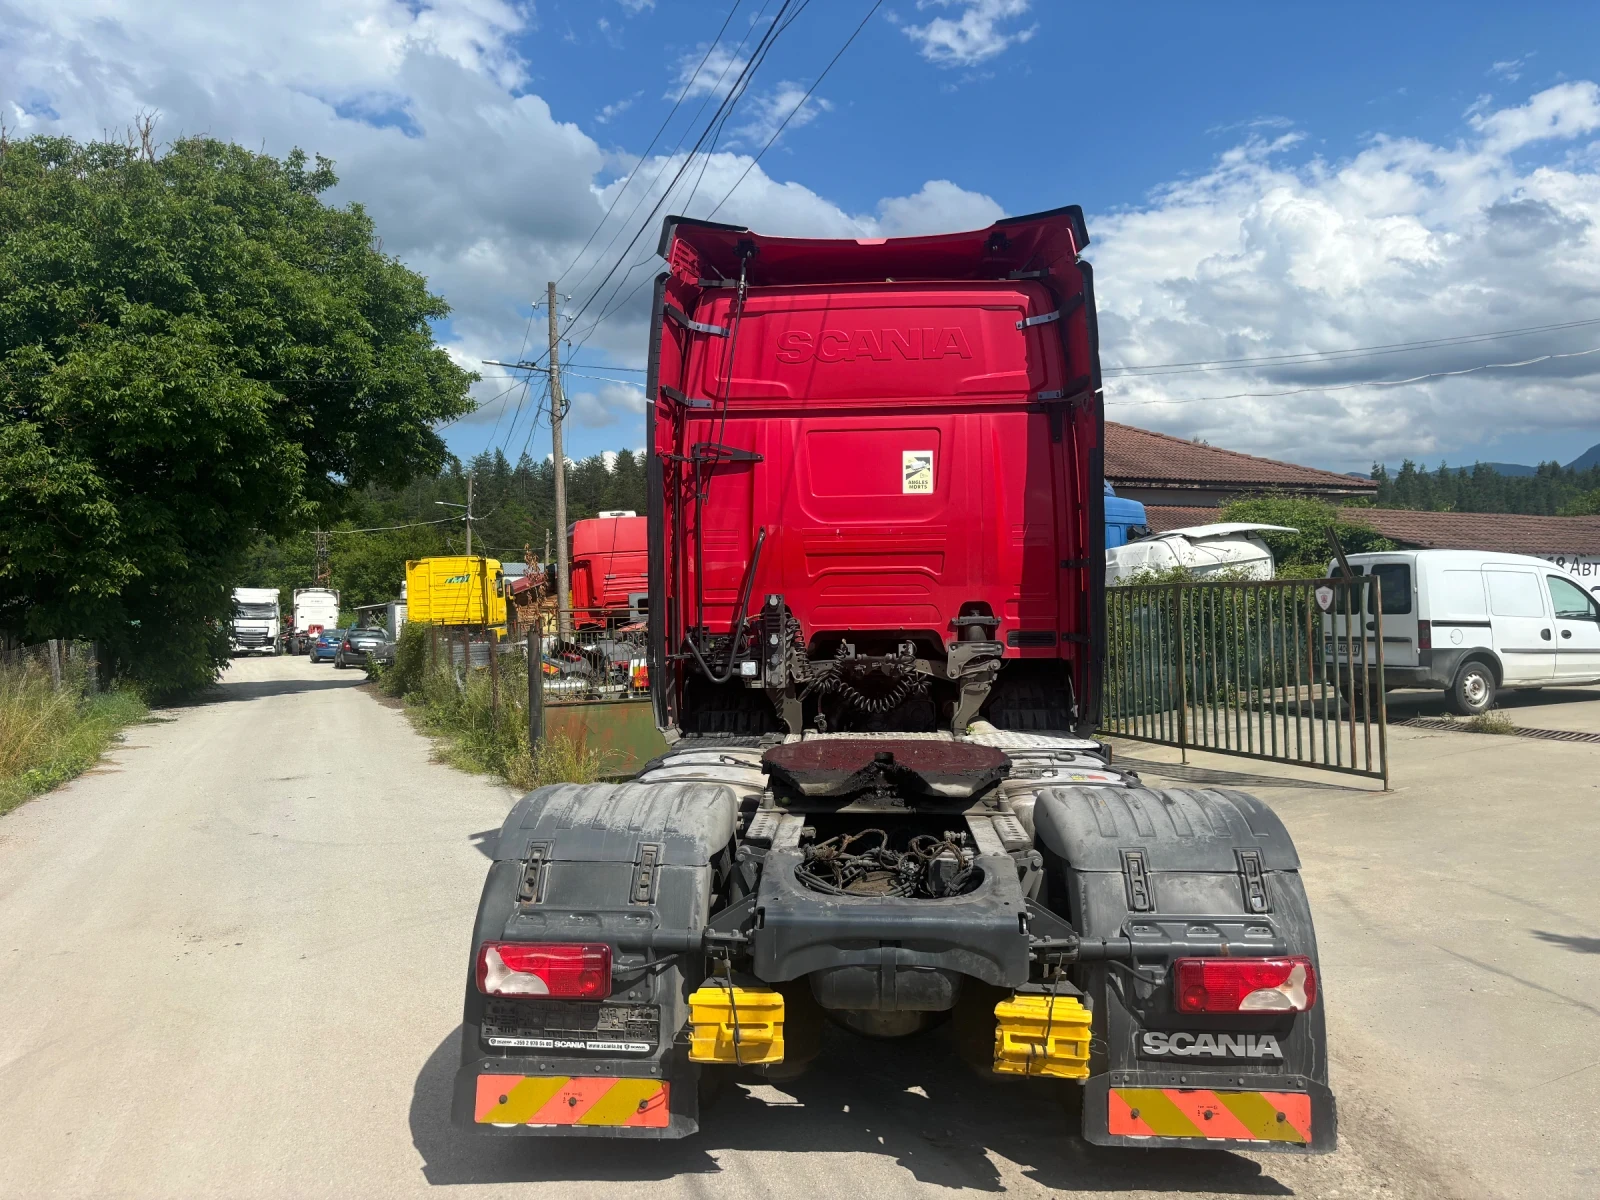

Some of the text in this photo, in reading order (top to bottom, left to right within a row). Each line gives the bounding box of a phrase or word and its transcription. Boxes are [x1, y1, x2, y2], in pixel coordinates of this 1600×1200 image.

[776, 327, 973, 364] SCANIA
[554, 1041, 586, 1049] SCANIA
[1142, 1032, 1283, 1058] SCANIA
